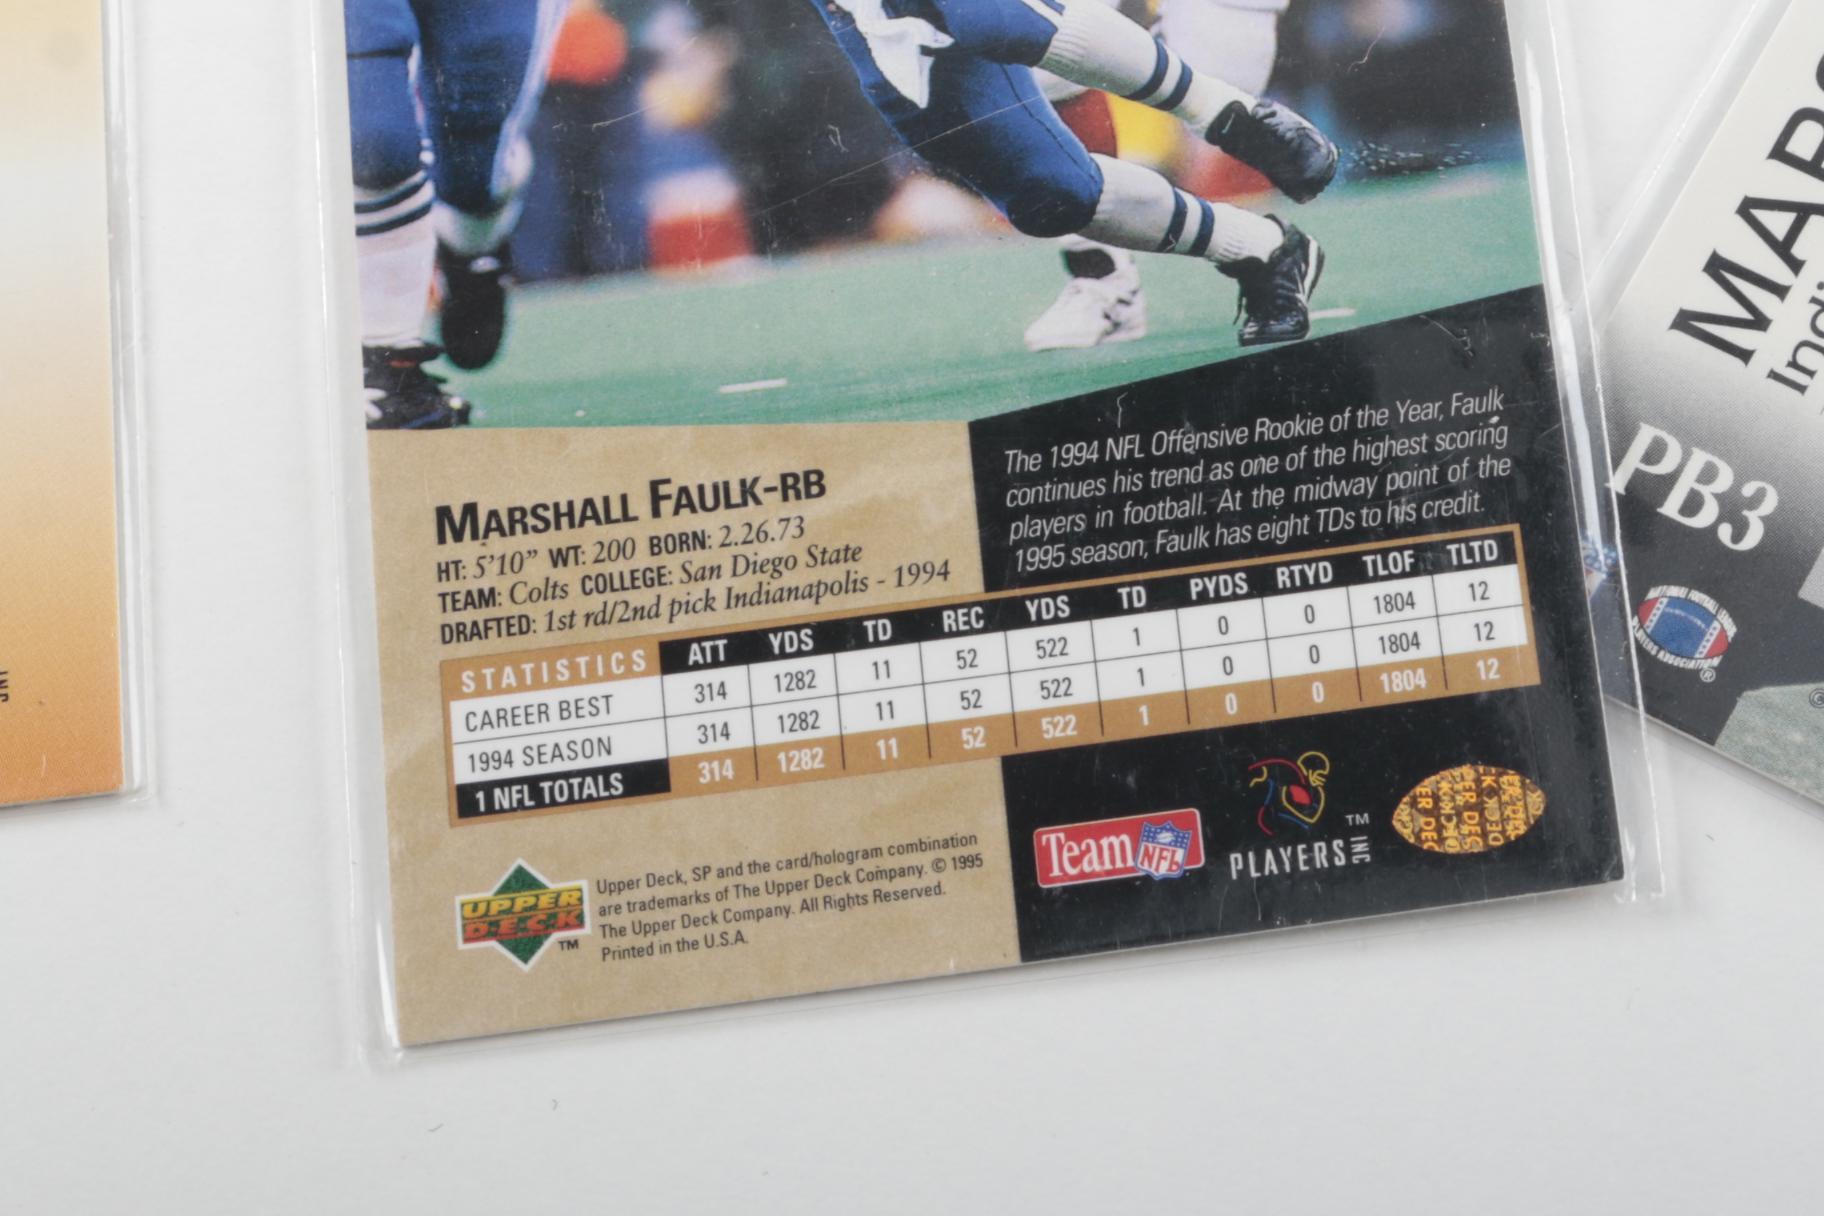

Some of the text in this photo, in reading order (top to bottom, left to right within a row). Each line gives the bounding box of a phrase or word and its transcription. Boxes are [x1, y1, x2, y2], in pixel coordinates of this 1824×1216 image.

[1004, 387, 1505, 474] The 1994 NFL Offensive Rookie of the Year, Faulk
[1005, 417, 1509, 508] continues his trend as one of the highest scoring
[434, 468, 827, 546] MARSHALL FAULK-RB
[1604, 422, 1779, 551] PB3
[436, 558, 467, 583] HT:
[547, 544, 586, 569] WT:
[592, 536, 636, 564] 200
[648, 529, 712, 557] BORN:
[718, 515, 805, 548] 2.26.73
[437, 543, 863, 614] TEAM: Colts COLLEGE: San Diego State
[440, 558, 950, 645] DRAFTED: 1st rd/2nd pick Indianapolis 1994
[461, 538, 1499, 693] STATISTICS ATT YDS TD REC YDS TD PYDS RTYD TLOF TLTD
[596, 834, 978, 897] Upper Deck, SP and the card/hologram combination
[1041, 829, 1188, 877] Team NFL
[1229, 842, 1347, 881] PLAYERS
[462, 888, 582, 921] UPPER
